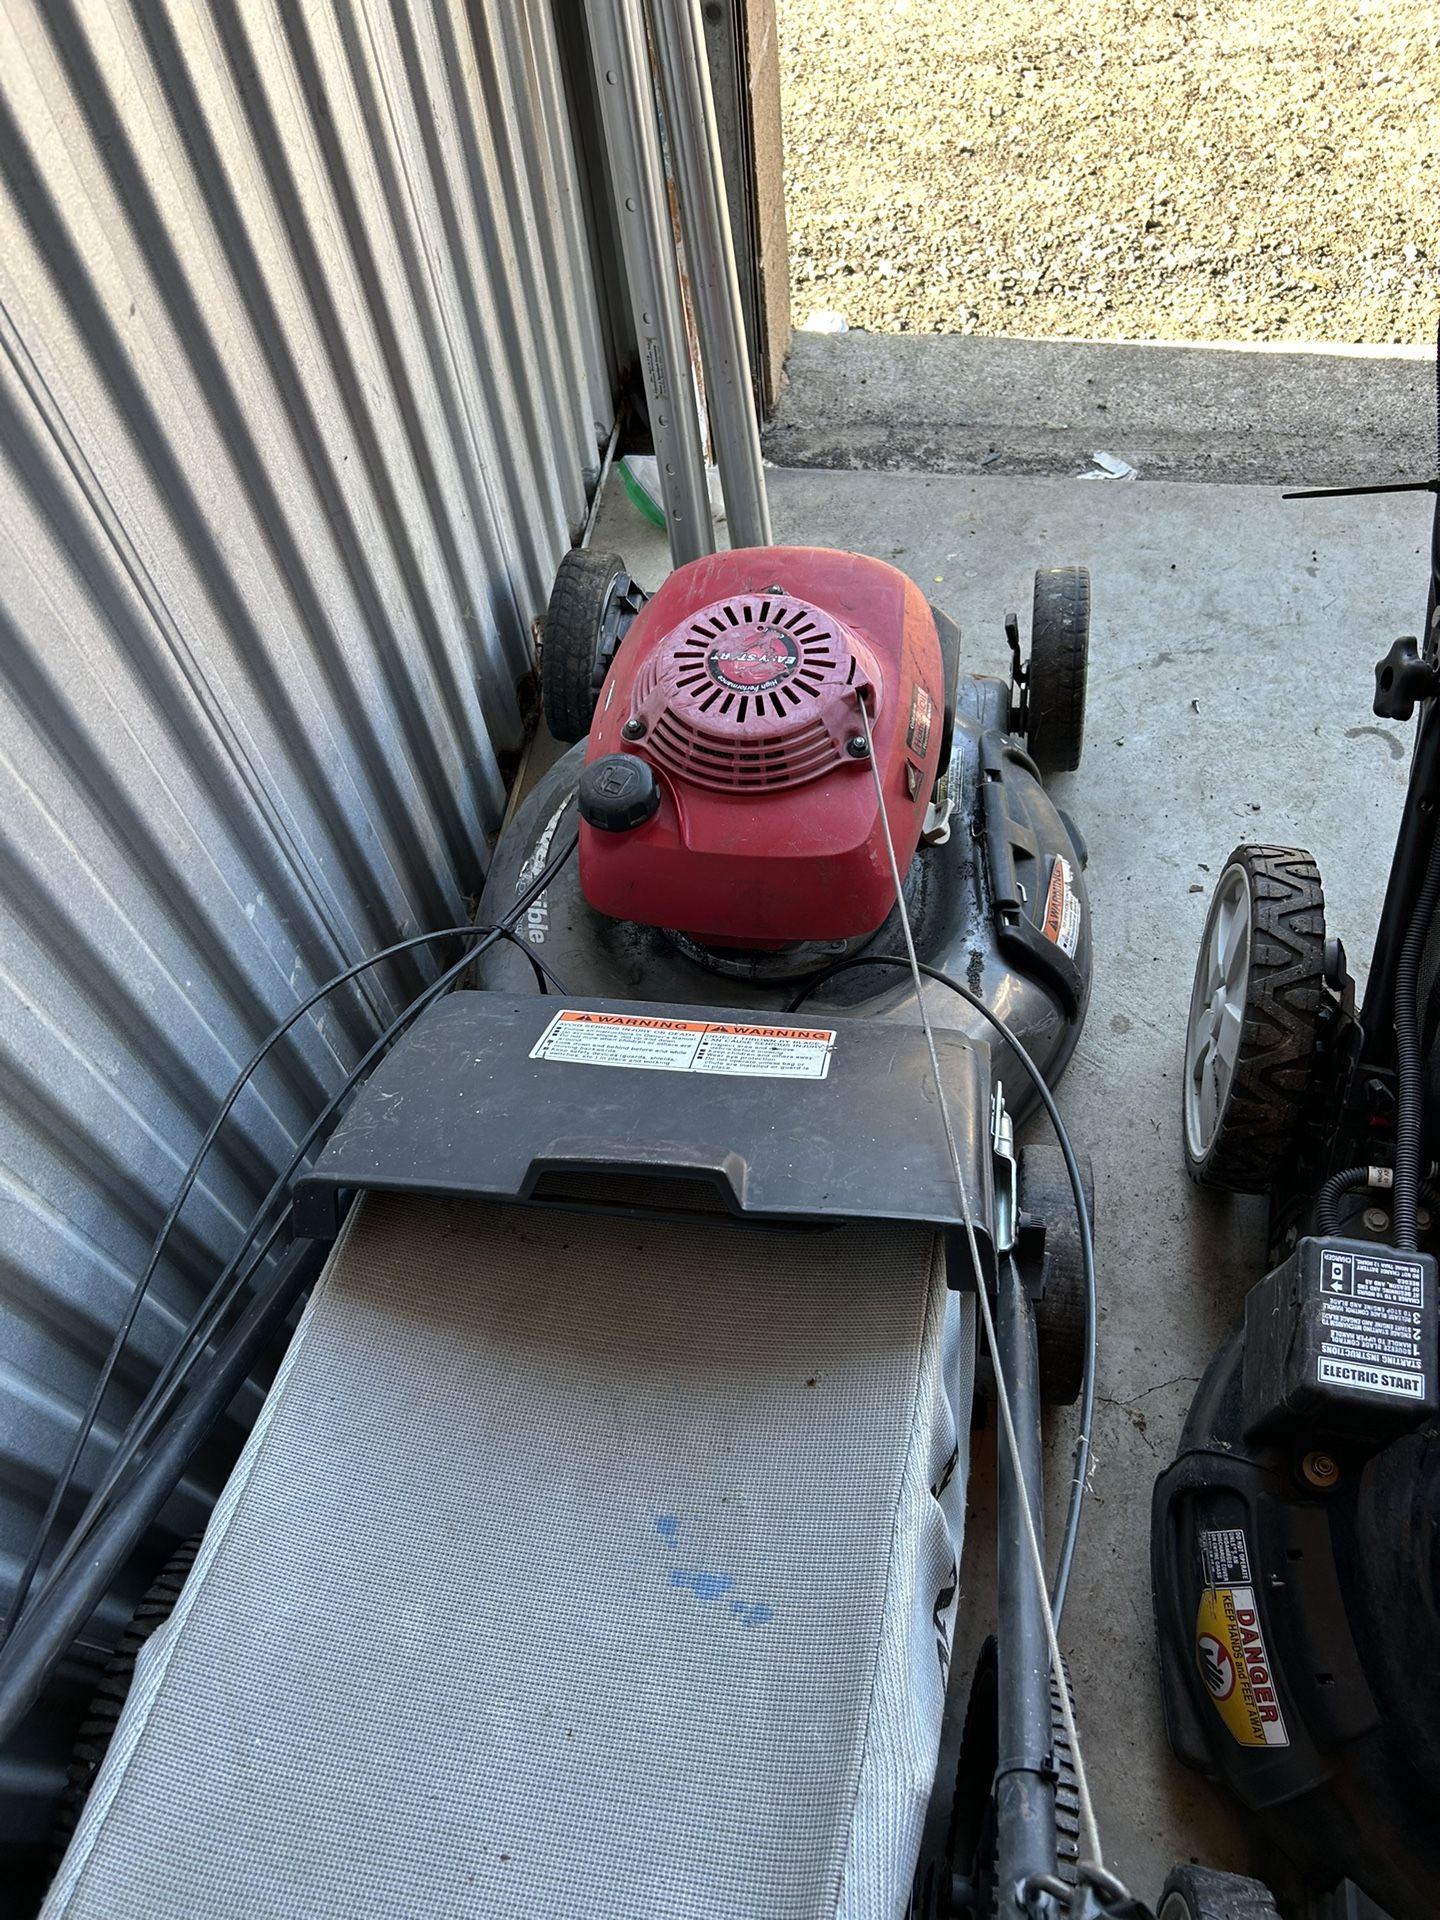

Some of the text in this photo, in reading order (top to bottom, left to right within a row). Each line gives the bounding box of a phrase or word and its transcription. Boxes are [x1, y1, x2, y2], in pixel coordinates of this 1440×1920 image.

[760, 679, 777, 688] High
[1050, 870, 1061, 918] WARNING
[596, 1016, 689, 1029] WARNING
[732, 1027, 825, 1039] WARNING
[1323, 1253, 1351, 1263] CHARGER
[1356, 1264, 1378, 1273] BATTERY
[1380, 1268, 1400, 1276] CHARGE
[1344, 1306, 1369, 1315] CONTROL
[1370, 1310, 1386, 1318] BLADE
[1412, 1311, 1420, 1324] 3
[1330, 1329, 1354, 1339] HANDLE
[1362, 1325, 1388, 1334] STARTING
[1412, 1327, 1420, 1340] 2
[1331, 1336, 1359, 1346] CONTROL
[1355, 1333, 1376, 1342] UPPER
[1361, 1341, 1381, 1349] BLADE
[1387, 1339, 1411, 1348] HANDLE
[1412, 1343, 1419, 1356] 1
[1321, 1344, 1421, 1368] STARTING INSTRUCTIONS
[1323, 1363, 1418, 1391] ELECTRIC START
[1216, 1532, 1225, 1562] DISCHARGE
[1235, 1531, 1241, 1539] DO
[1238, 1553, 1248, 1578] OPERATE
[1223, 1595, 1263, 1739] KEEP HANDS and FEET AWAY
[1236, 1609, 1278, 1722] DANGER
